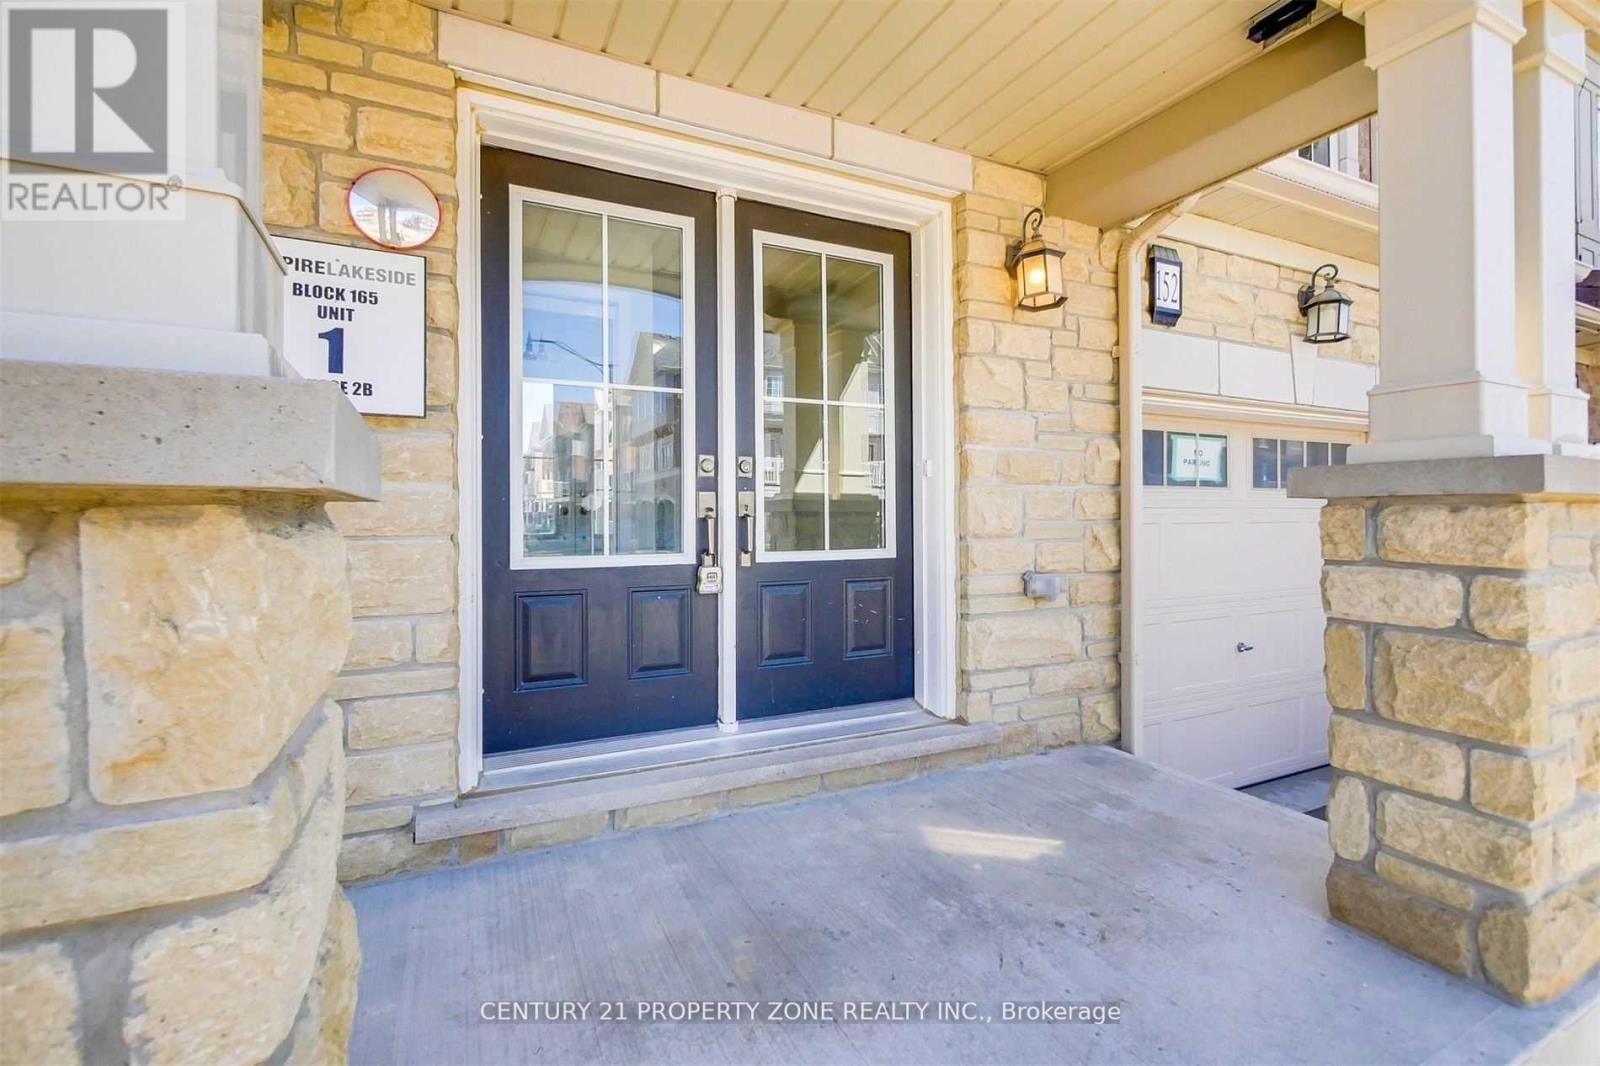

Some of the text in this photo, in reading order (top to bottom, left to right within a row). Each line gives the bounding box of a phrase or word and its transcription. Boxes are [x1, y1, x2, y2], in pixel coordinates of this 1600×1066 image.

[282, 255, 417, 286] PIRELAKESIDE
[292, 282, 378, 305] BLOCK 165
[1156, 270, 1178, 303] 152
[317, 305, 355, 321] UNIT
[318, 327, 344, 374] 1
[352, 382, 373, 396] 2B
